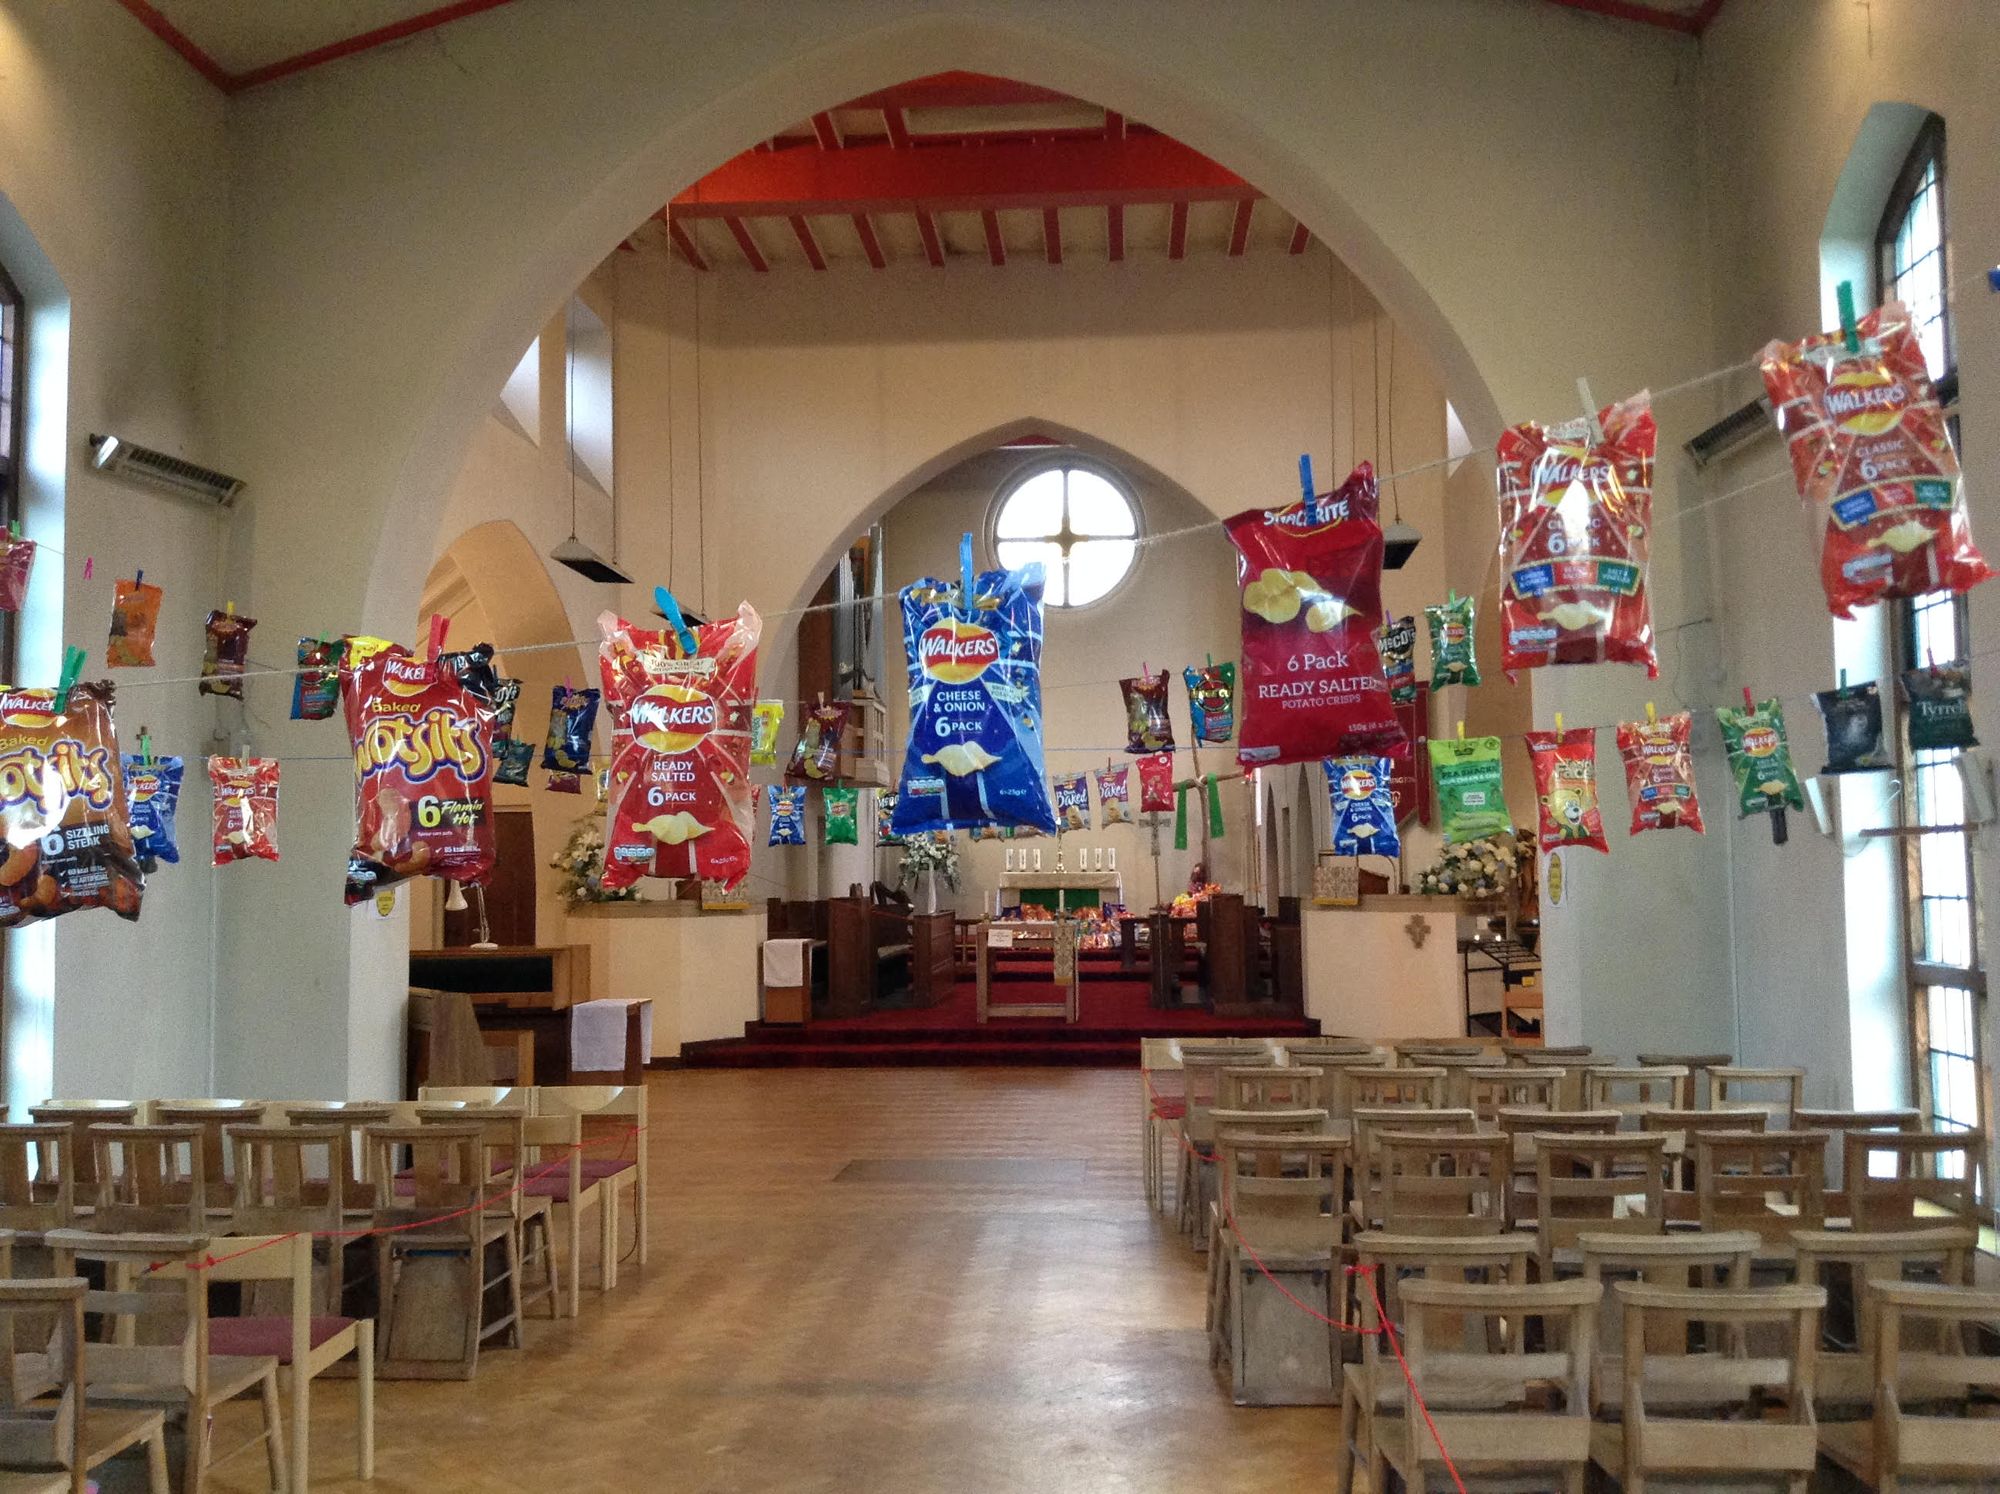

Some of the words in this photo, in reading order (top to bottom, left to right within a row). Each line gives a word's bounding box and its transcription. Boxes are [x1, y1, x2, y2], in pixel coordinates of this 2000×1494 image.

[1826, 384, 1905, 413] WALKERS
[1533, 464, 1609, 484] WALKERS
[1861, 459, 1878, 481] 6
[1264, 500, 1349, 526] SNACRITE
[1548, 532, 1566, 554] 6
[921, 636, 996, 657] WALKERS
[1287, 655, 1299, 671] 6
[1304, 651, 1348, 671] Pack
[937, 690, 981, 701] CHEESE
[1259, 681, 1315, 699] READY
[372, 700, 421, 713] Baked
[934, 704, 942, 713] &
[944, 701, 986, 712] ONION
[1282, 696, 1324, 709] POTATO
[1326, 694, 1361, 706] CRISPS
[935, 716, 951, 737] 6
[952, 721, 983, 731] PACK
[0, 735, 49, 751] Baked
[653, 760, 694, 772] READY
[651, 771, 696, 783] SALTED
[647, 785, 664, 807] 6
[665, 791, 697, 802] PACK
[1056, 788, 1088, 807] Baked
[418, 795, 441, 828] 6
[452, 811, 479, 825] Hot
[66, 824, 110, 841] SIZZLING
[67, 836, 101, 850] STEAK
